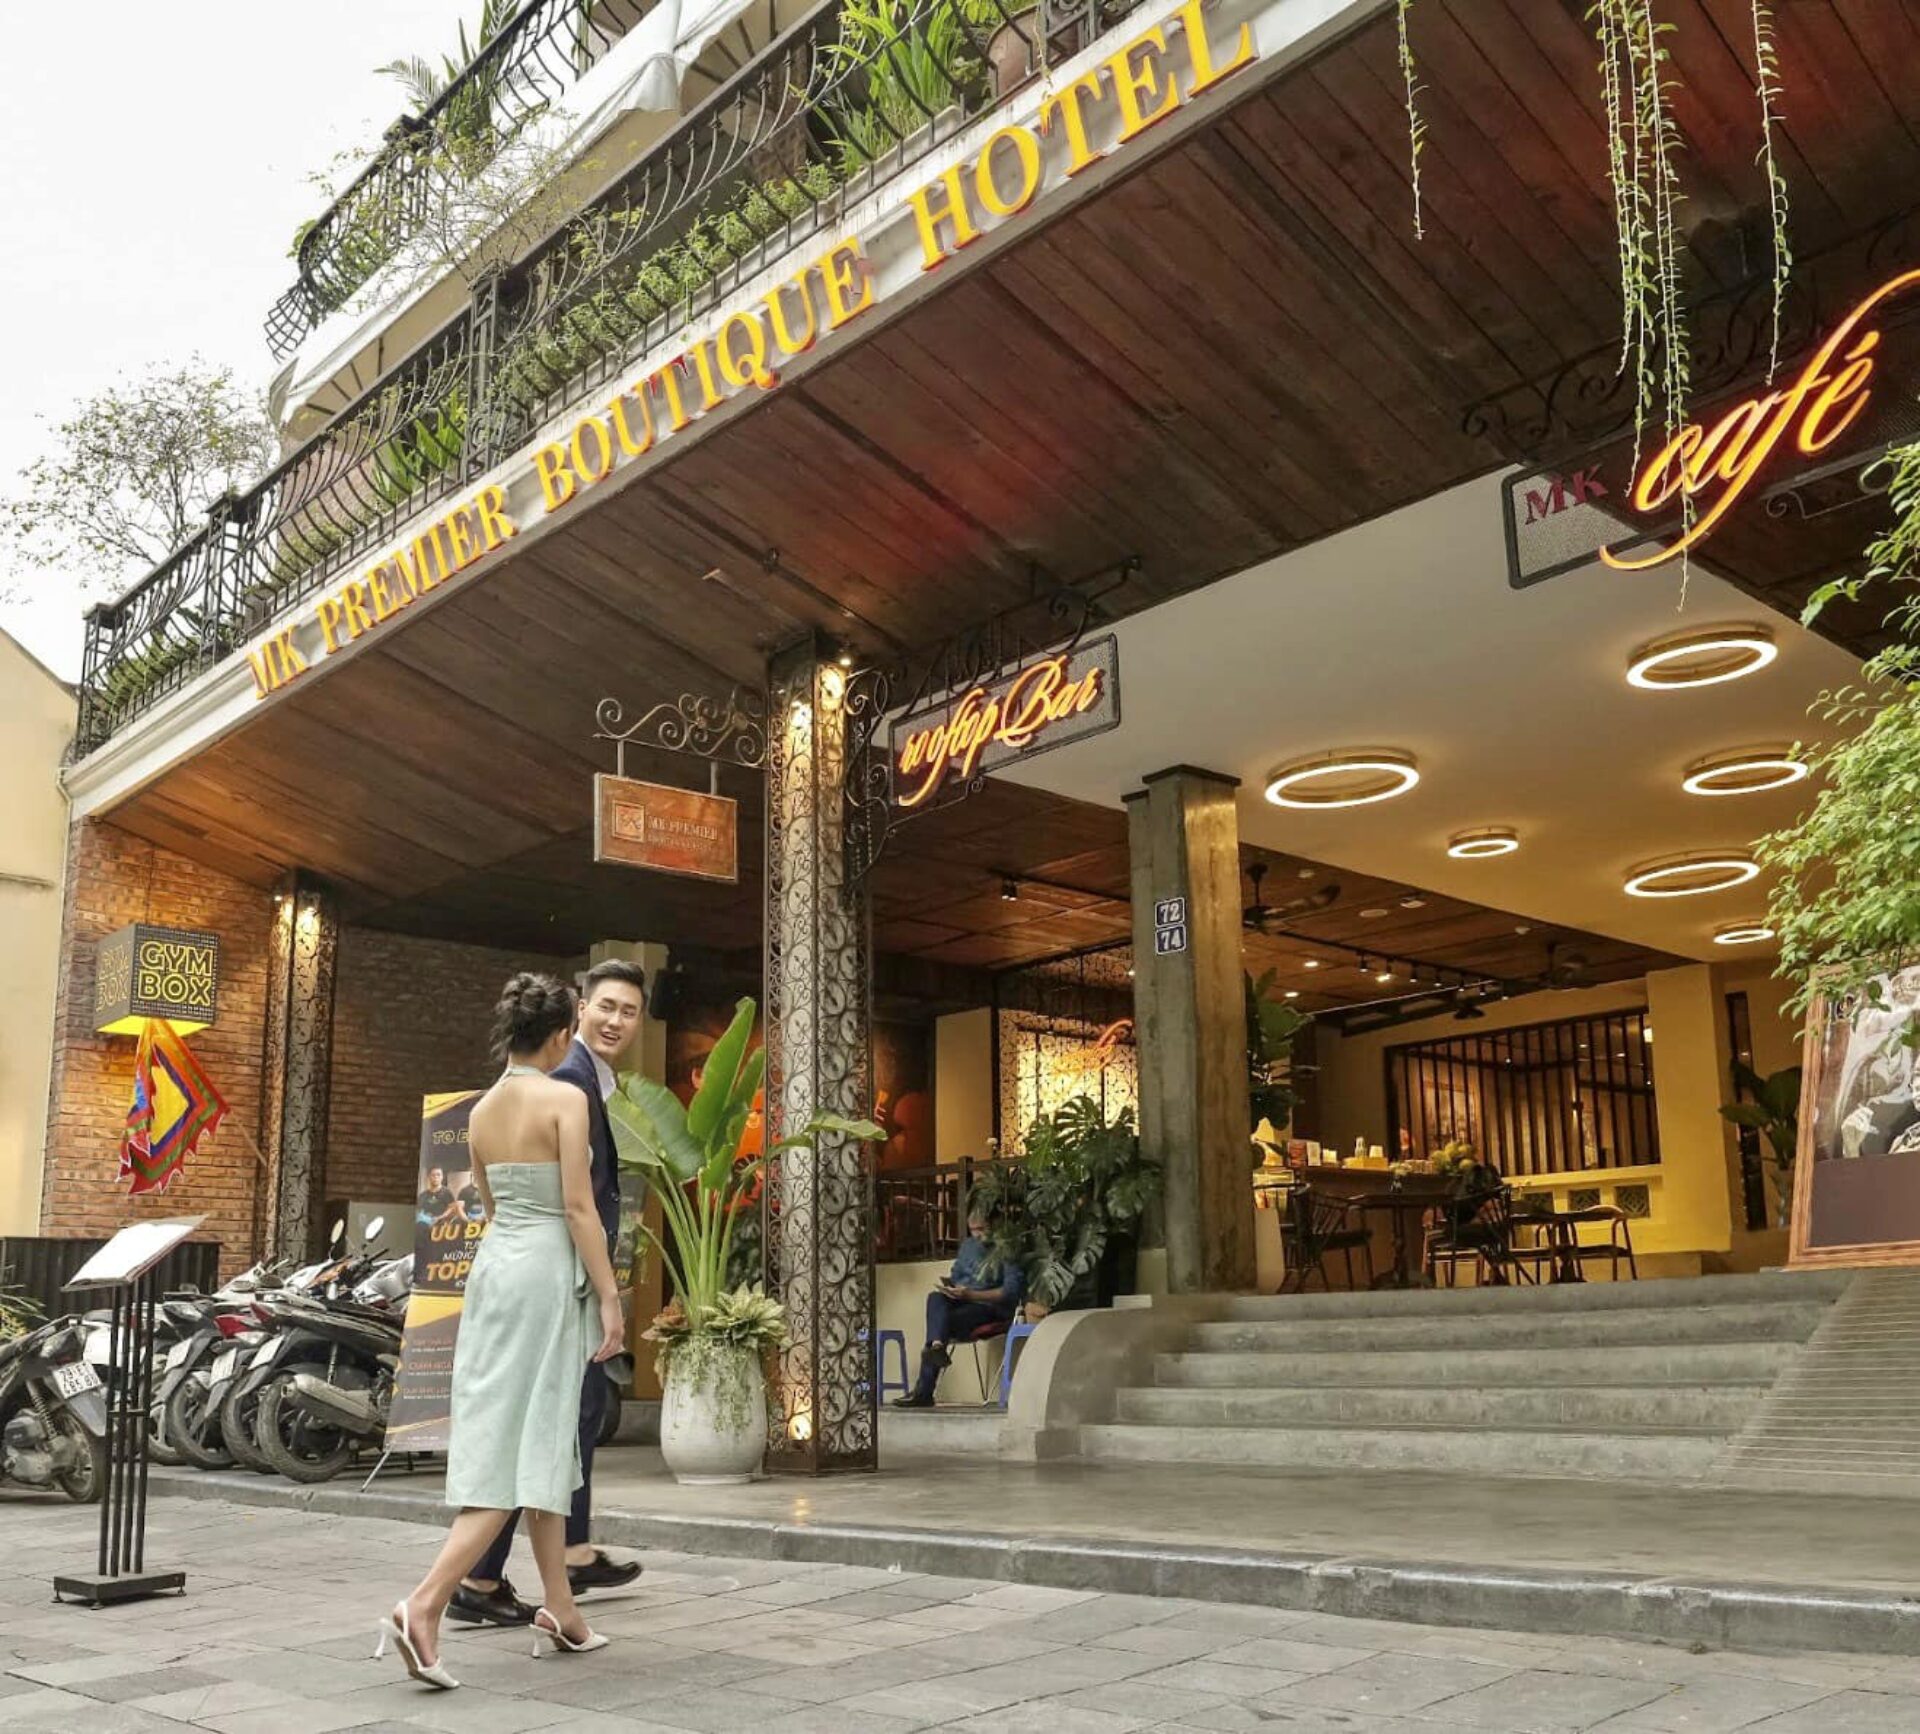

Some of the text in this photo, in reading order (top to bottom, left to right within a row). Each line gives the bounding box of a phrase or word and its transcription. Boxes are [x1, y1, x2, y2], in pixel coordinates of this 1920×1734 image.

[245, 0, 1259, 700] MK PREMIER BOUTIQUE HOTEL
[1525, 268, 1920, 569] MK café
[993, 654, 1101, 748] Bar
[1159, 902, 1181, 923] 72
[1160, 929, 1182, 950] 74
[140, 941, 214, 977] GYM
[138, 969, 212, 1007] BOX
